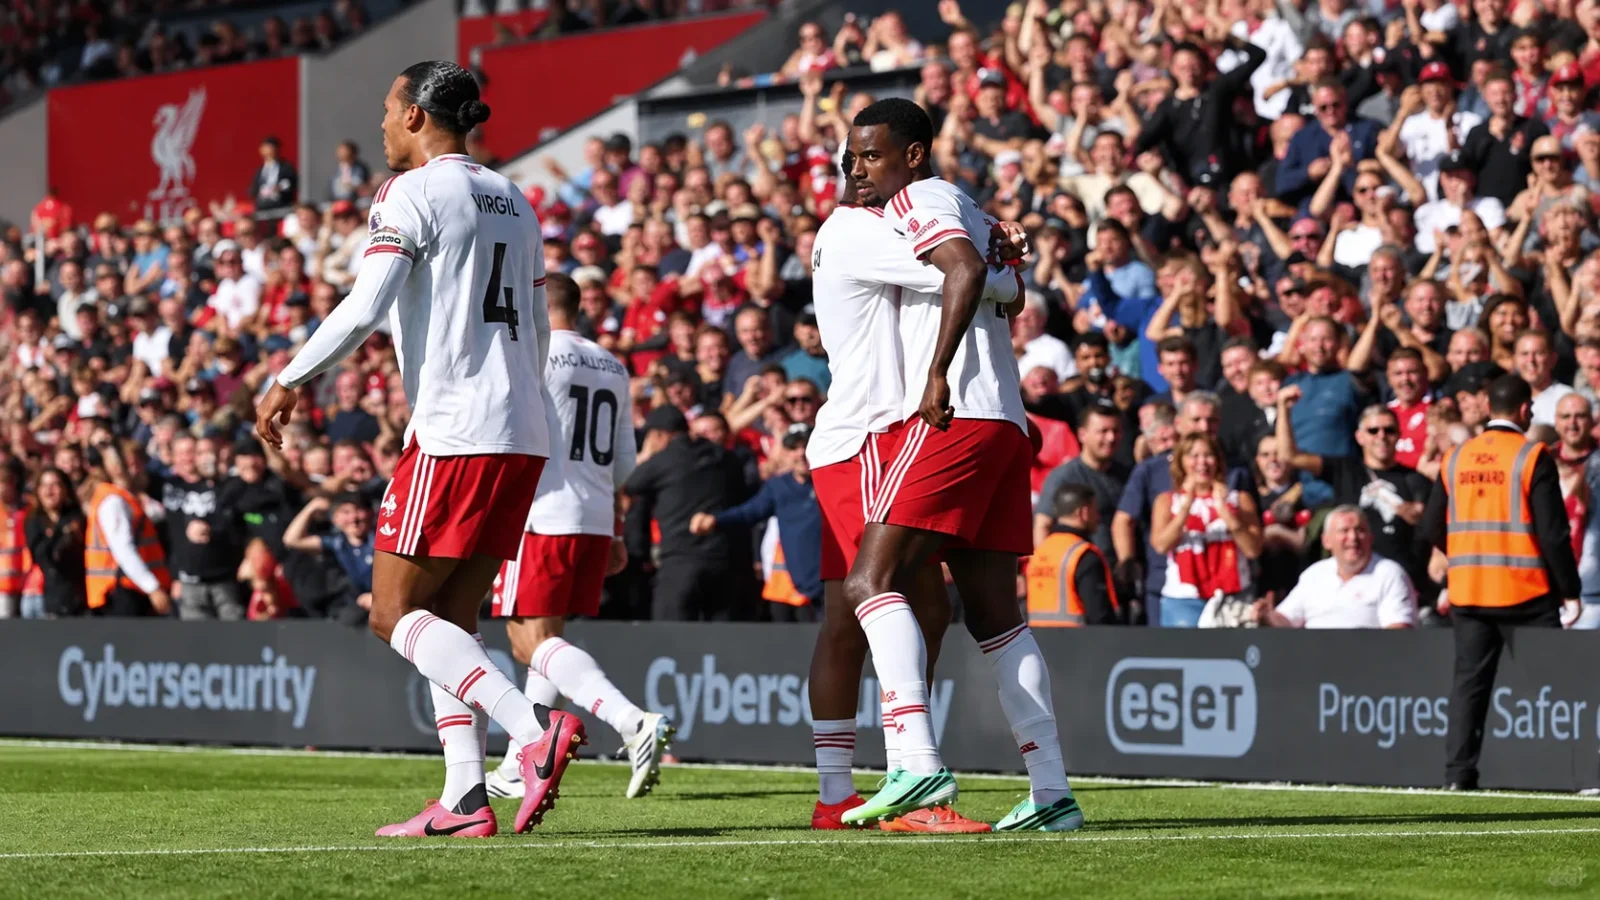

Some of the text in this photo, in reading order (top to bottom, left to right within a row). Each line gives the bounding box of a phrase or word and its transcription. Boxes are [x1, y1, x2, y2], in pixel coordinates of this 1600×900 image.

[471, 193, 520, 217] VIRGIL
[483, 242, 519, 341] 4
[549, 353, 578, 371] MAC
[568, 384, 618, 466] 10
[58, 644, 316, 728] Cybersecurity
[1318, 683, 1449, 748] Progres
[1493, 685, 1587, 740] Safer
